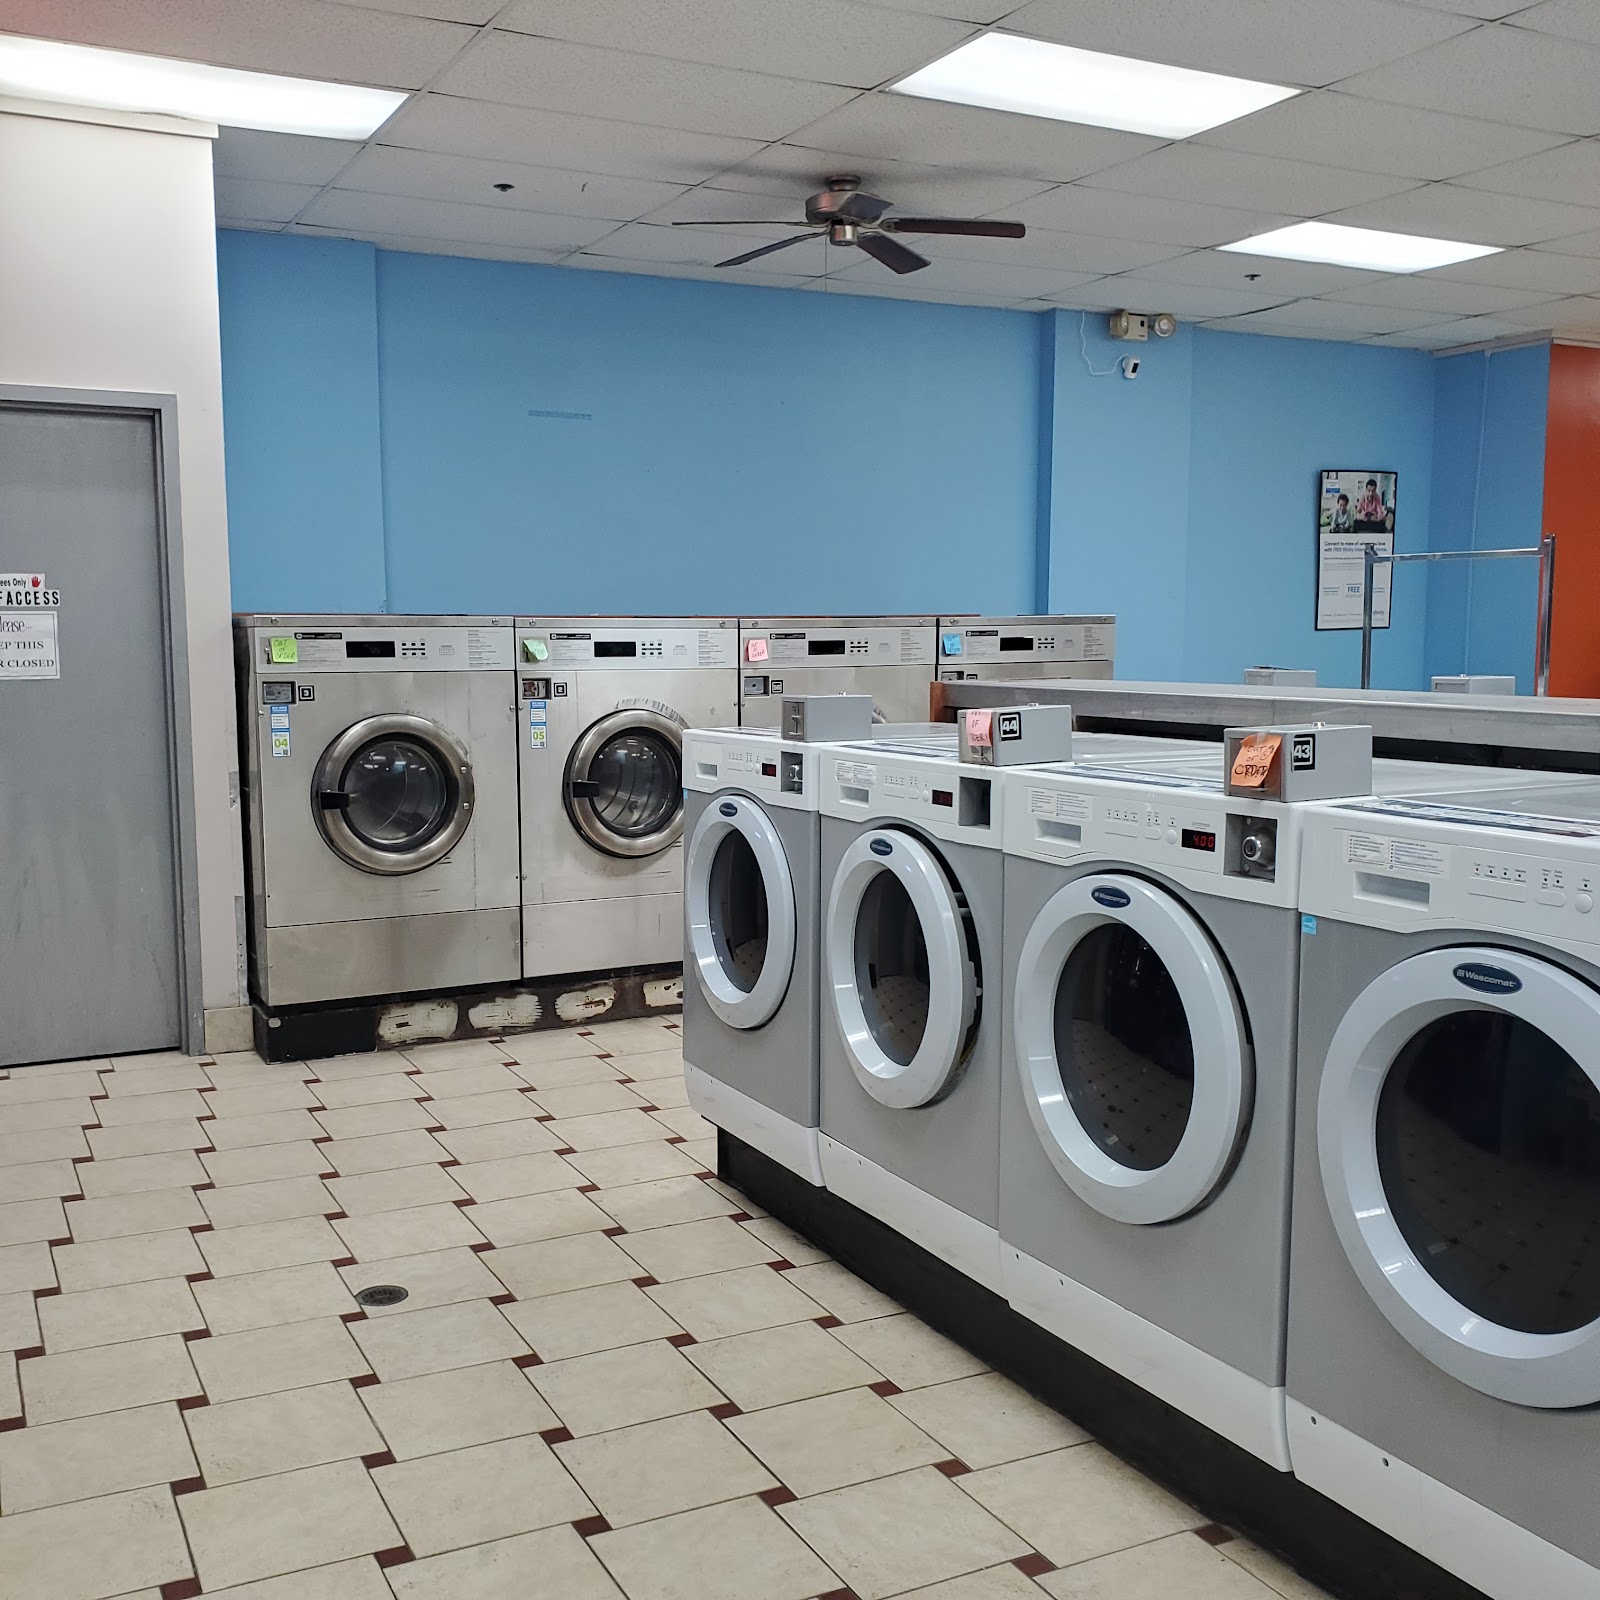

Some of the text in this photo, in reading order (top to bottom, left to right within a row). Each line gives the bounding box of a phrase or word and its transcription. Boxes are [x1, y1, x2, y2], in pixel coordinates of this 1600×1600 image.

[12, 577, 27, 589] Only
[1347, 586, 1361, 594] FREE
[6, 591, 59, 606] ACCESS
[13, 641, 45, 650] THIS
[7, 659, 55, 668] CLOSED
[1002, 719, 1018, 732] 44
[532, 731, 545, 740] 05
[274, 738, 288, 748] 04
[1293, 744, 1311, 758] 43
[1465, 970, 1517, 988] Wascomat
